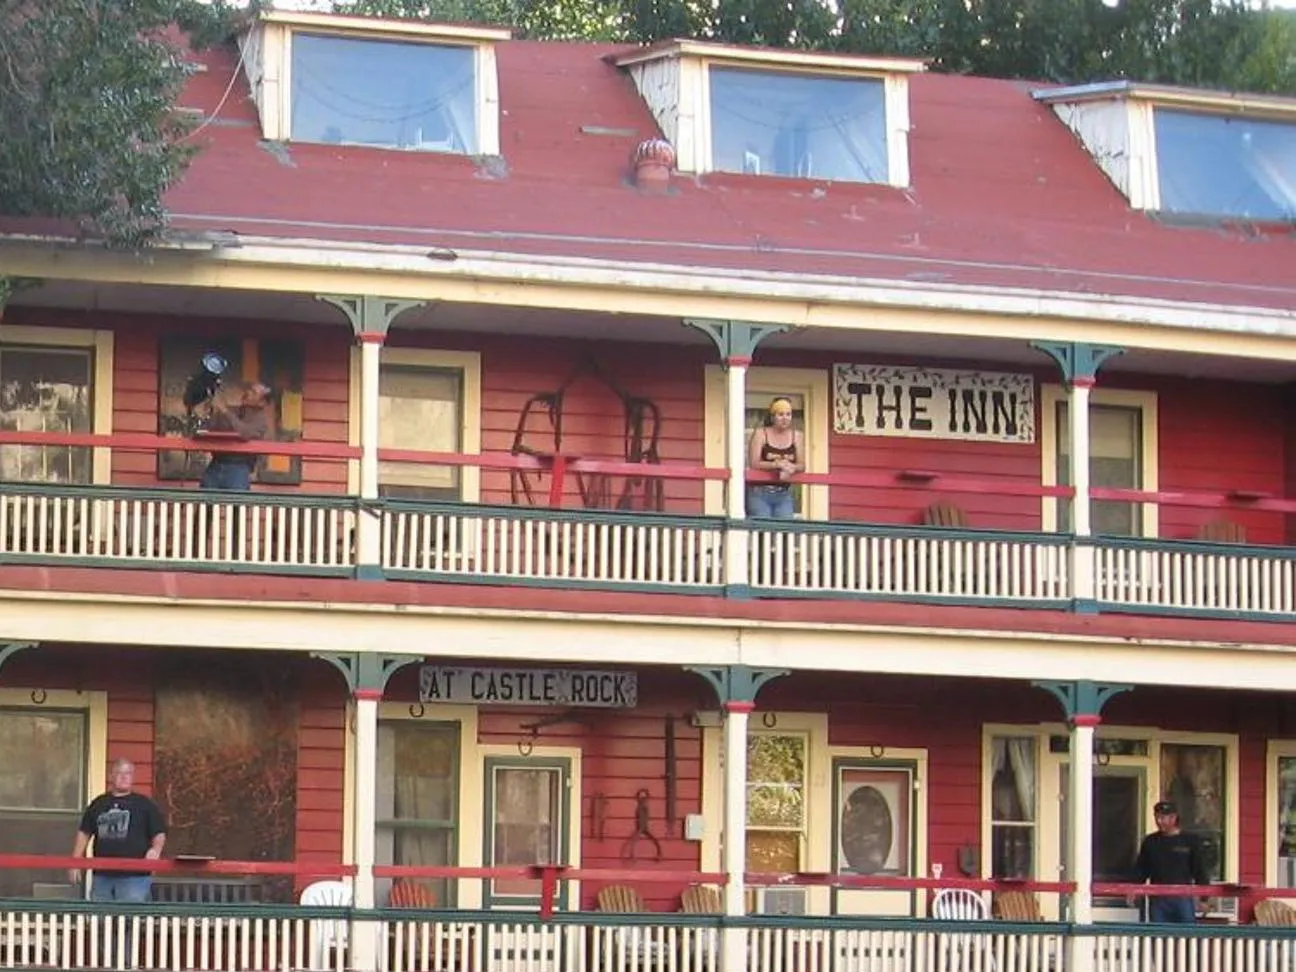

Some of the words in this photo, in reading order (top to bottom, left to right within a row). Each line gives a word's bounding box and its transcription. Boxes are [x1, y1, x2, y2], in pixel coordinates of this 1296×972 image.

[847, 382, 933, 431] THE
[948, 386, 1018, 436] INN
[427, 671, 455, 699] AT
[470, 672, 556, 701] CASTLE
[571, 674, 627, 704] ROCK
